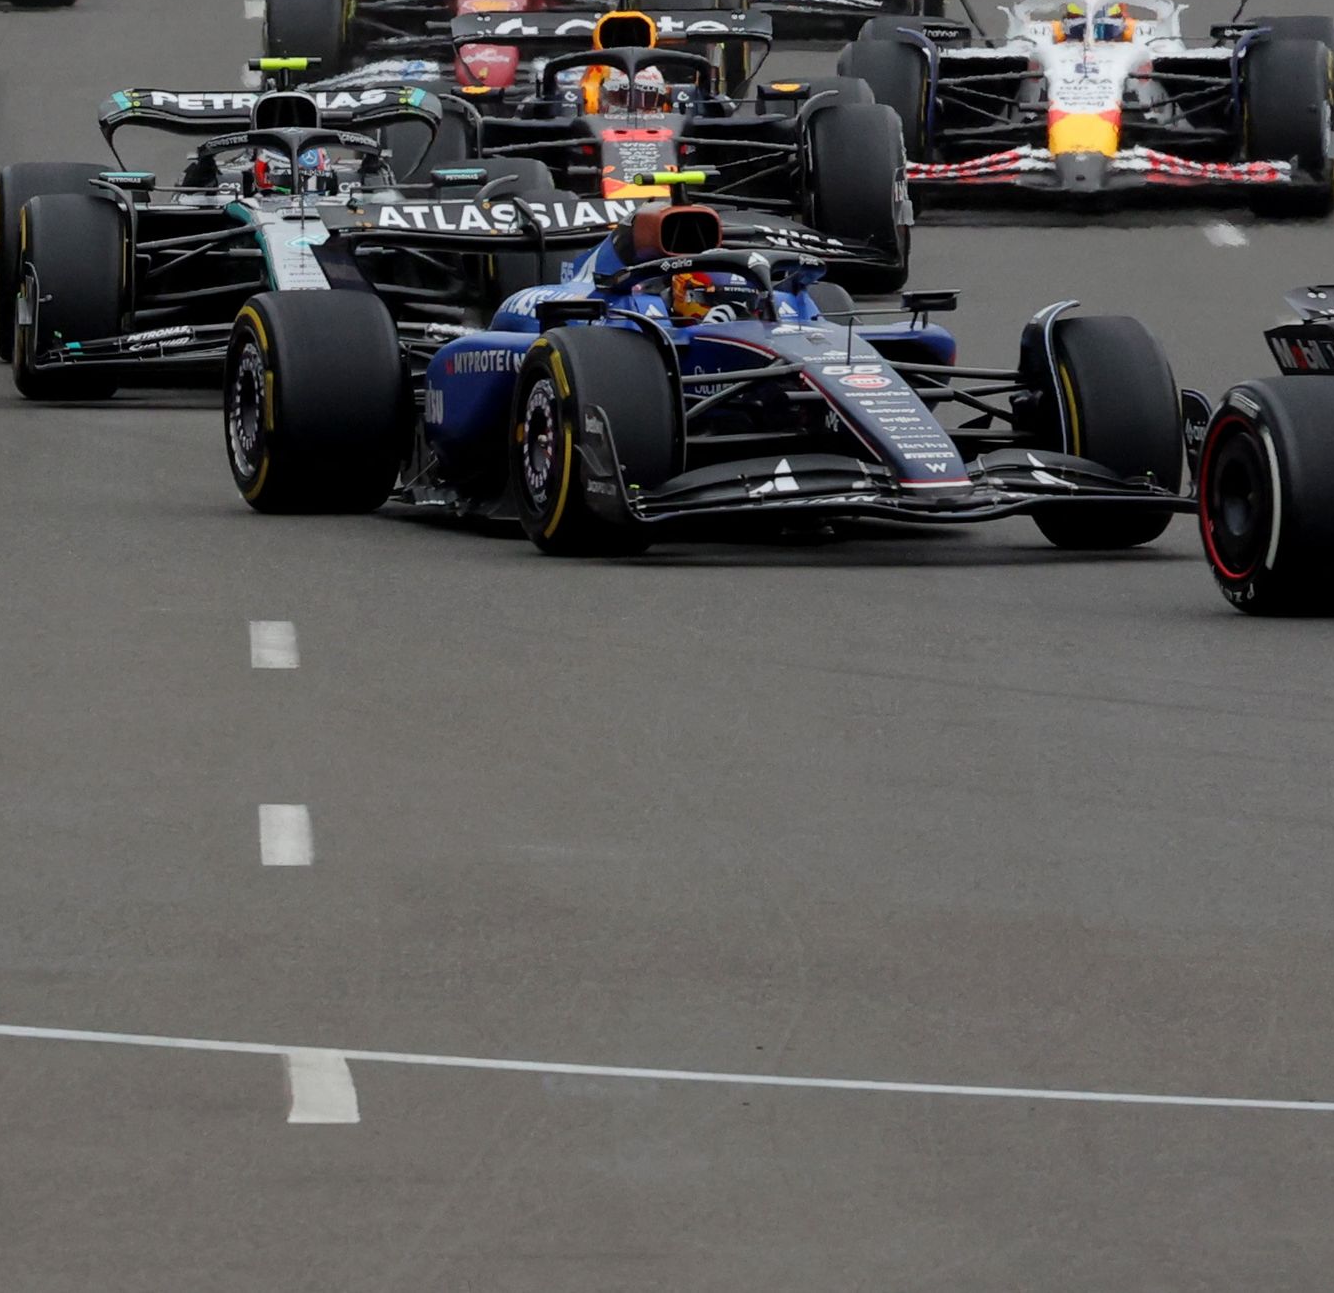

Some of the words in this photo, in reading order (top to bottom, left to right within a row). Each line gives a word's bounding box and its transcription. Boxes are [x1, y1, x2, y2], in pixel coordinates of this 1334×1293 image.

[107, 175, 142, 184] PETRONAS
[445, 173, 480, 182] PETRONAS
[378, 200, 637, 234] ATLASSIAN
[127, 325, 190, 343] PETRONAS
[821, 364, 883, 375] 55
